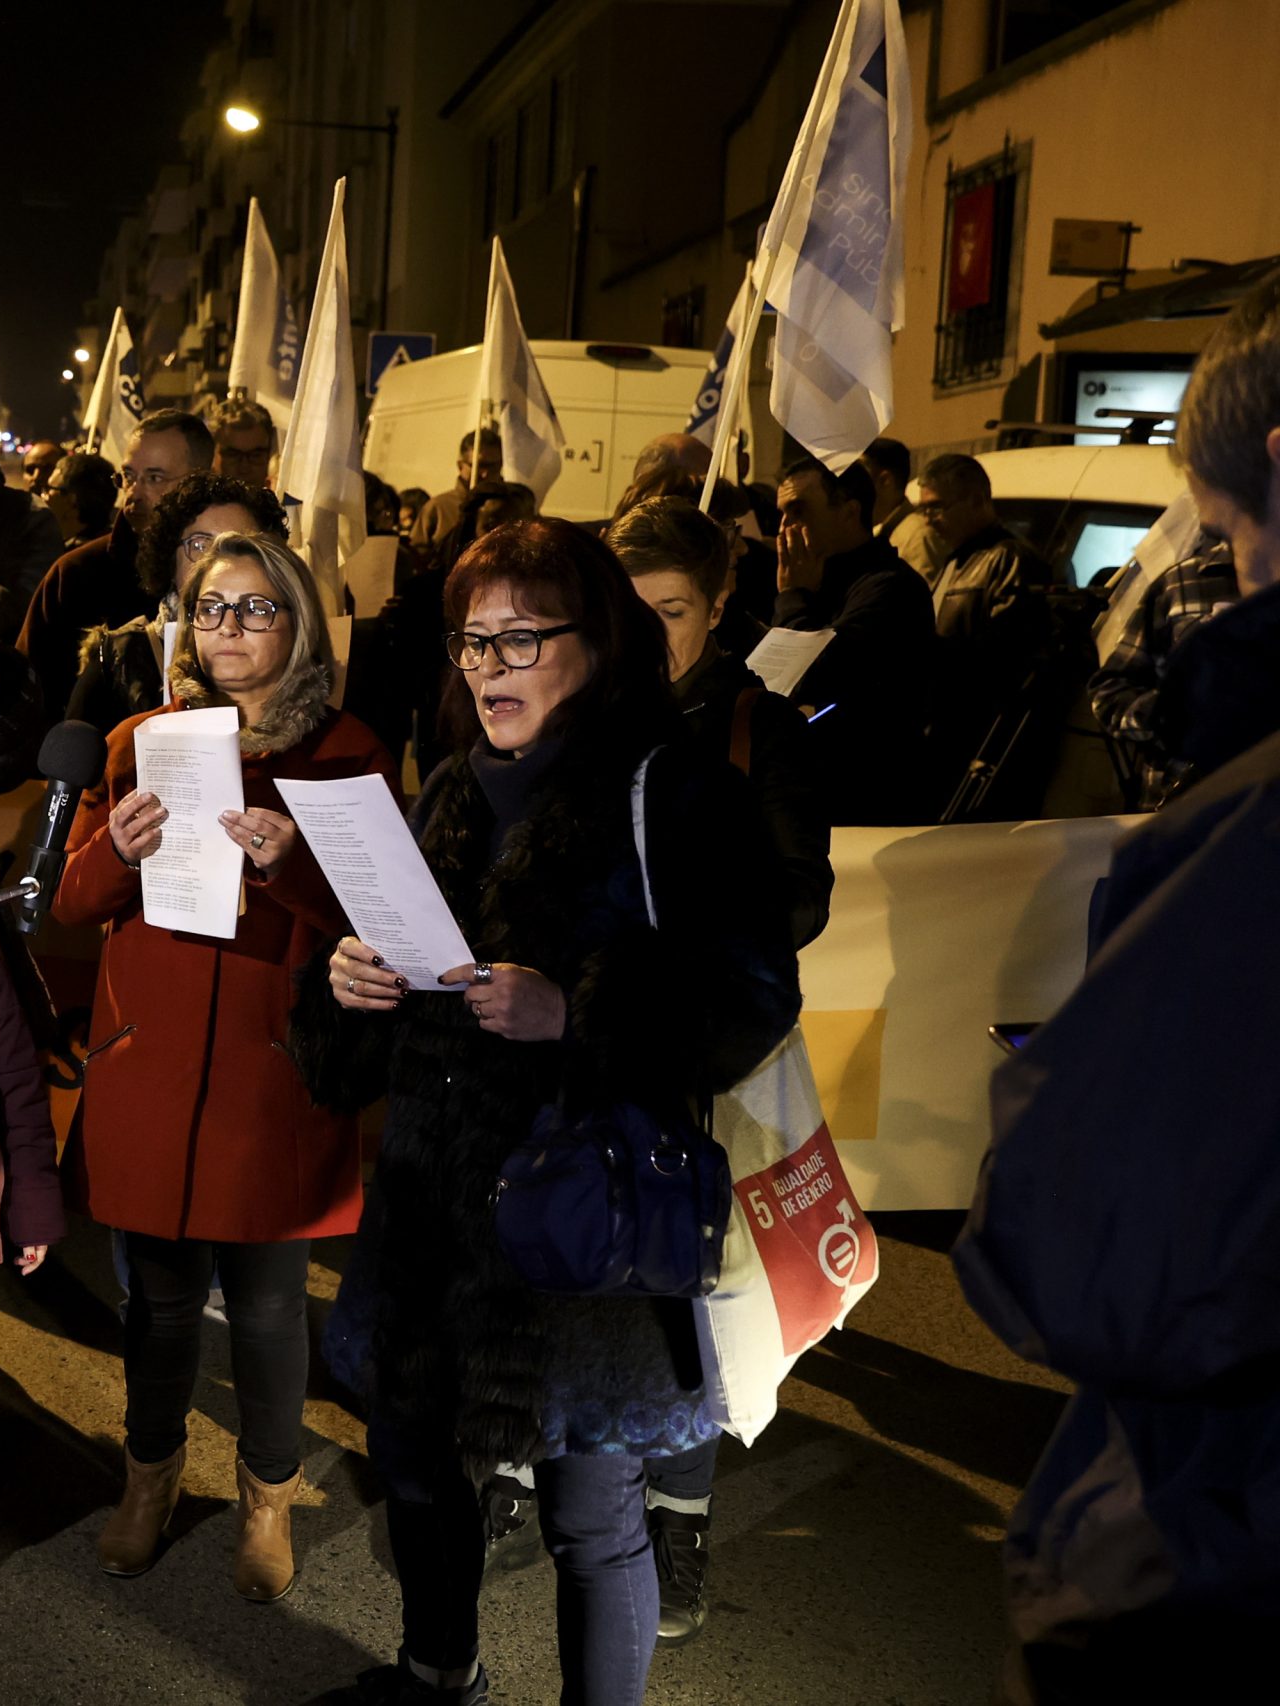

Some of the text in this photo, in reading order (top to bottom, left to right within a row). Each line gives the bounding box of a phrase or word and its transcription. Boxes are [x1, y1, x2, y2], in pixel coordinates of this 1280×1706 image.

[772, 1150, 826, 1197] IGUALDADE
[748, 1189, 774, 1229] 5
[781, 1197, 799, 1217] DE
